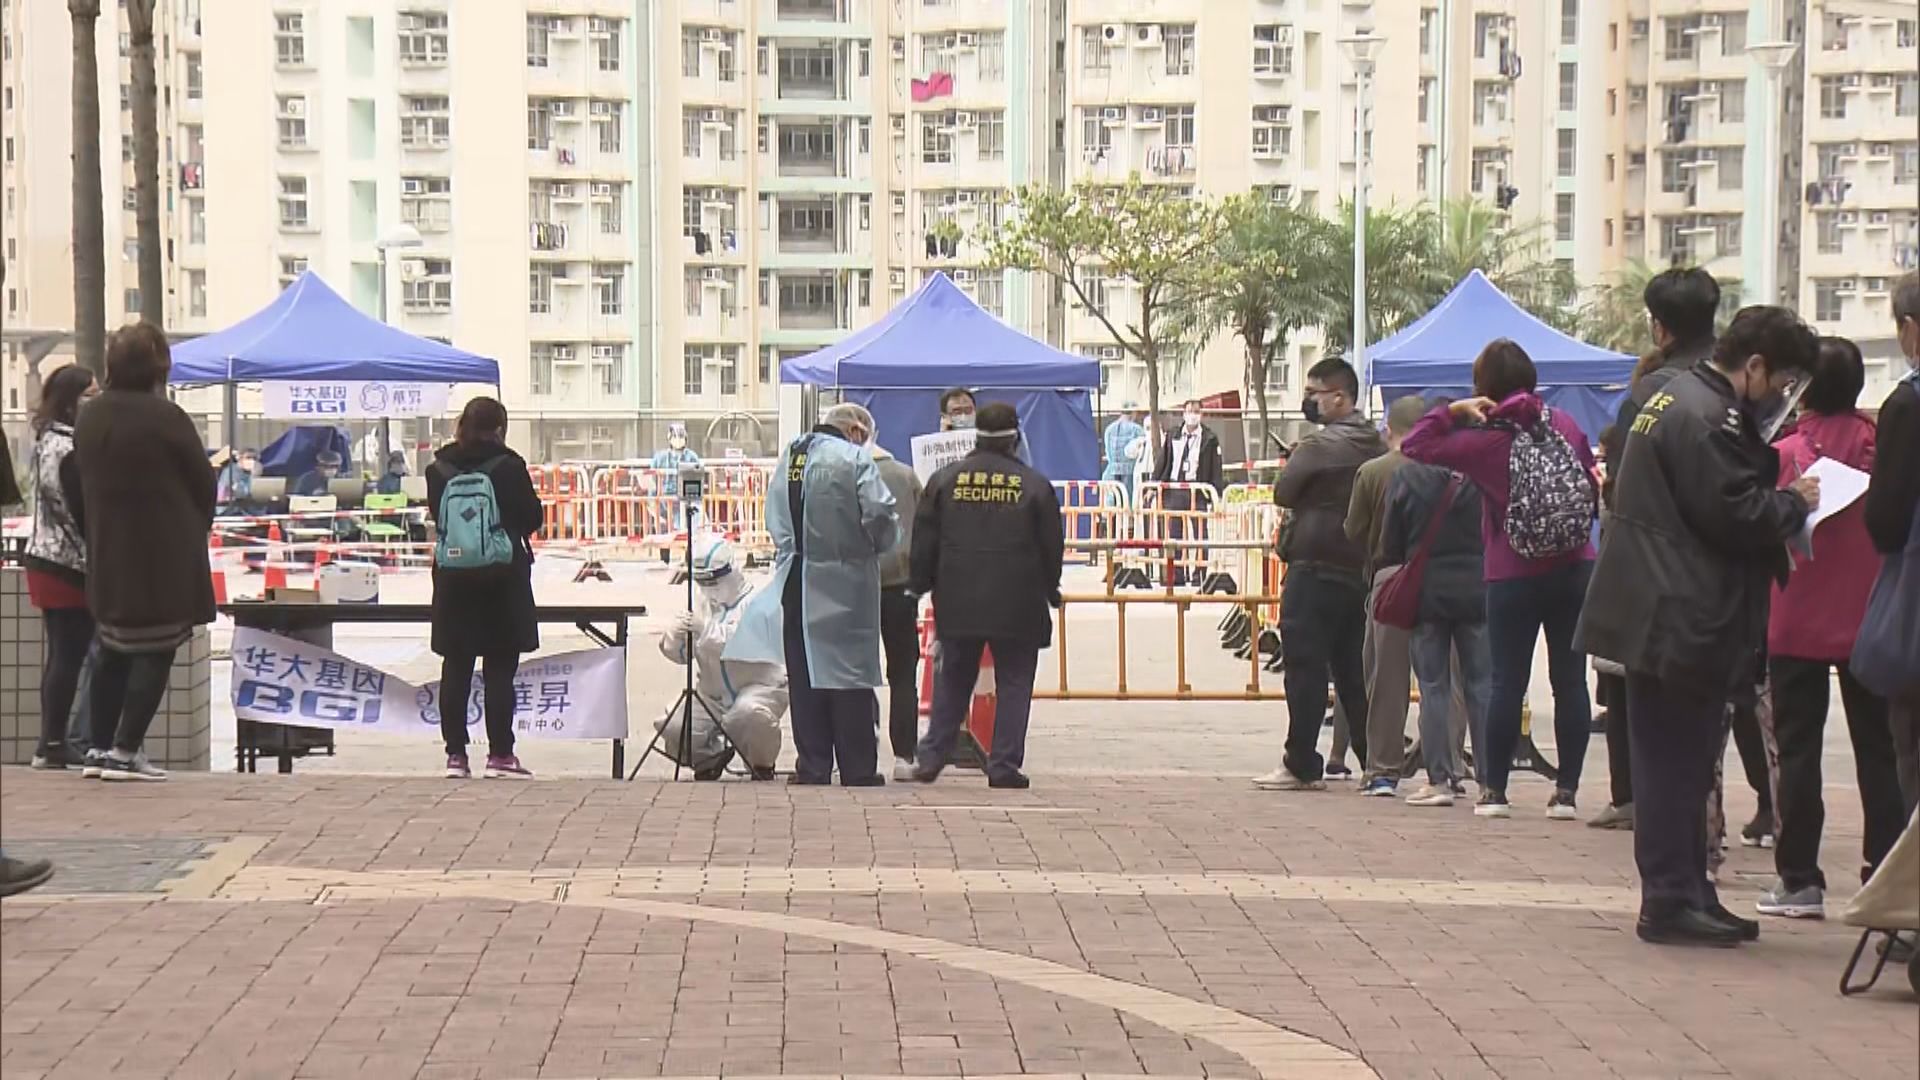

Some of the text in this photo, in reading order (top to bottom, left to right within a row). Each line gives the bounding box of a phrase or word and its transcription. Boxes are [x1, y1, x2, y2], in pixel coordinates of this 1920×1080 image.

[289, 385, 347, 400] 华大基因
[291, 400, 347, 414] BGI
[952, 486, 1023, 503] SECURITY
[243, 645, 386, 696] 华大基因
[236, 679, 382, 724] BGI
[518, 717, 565, 732] 斷中心
